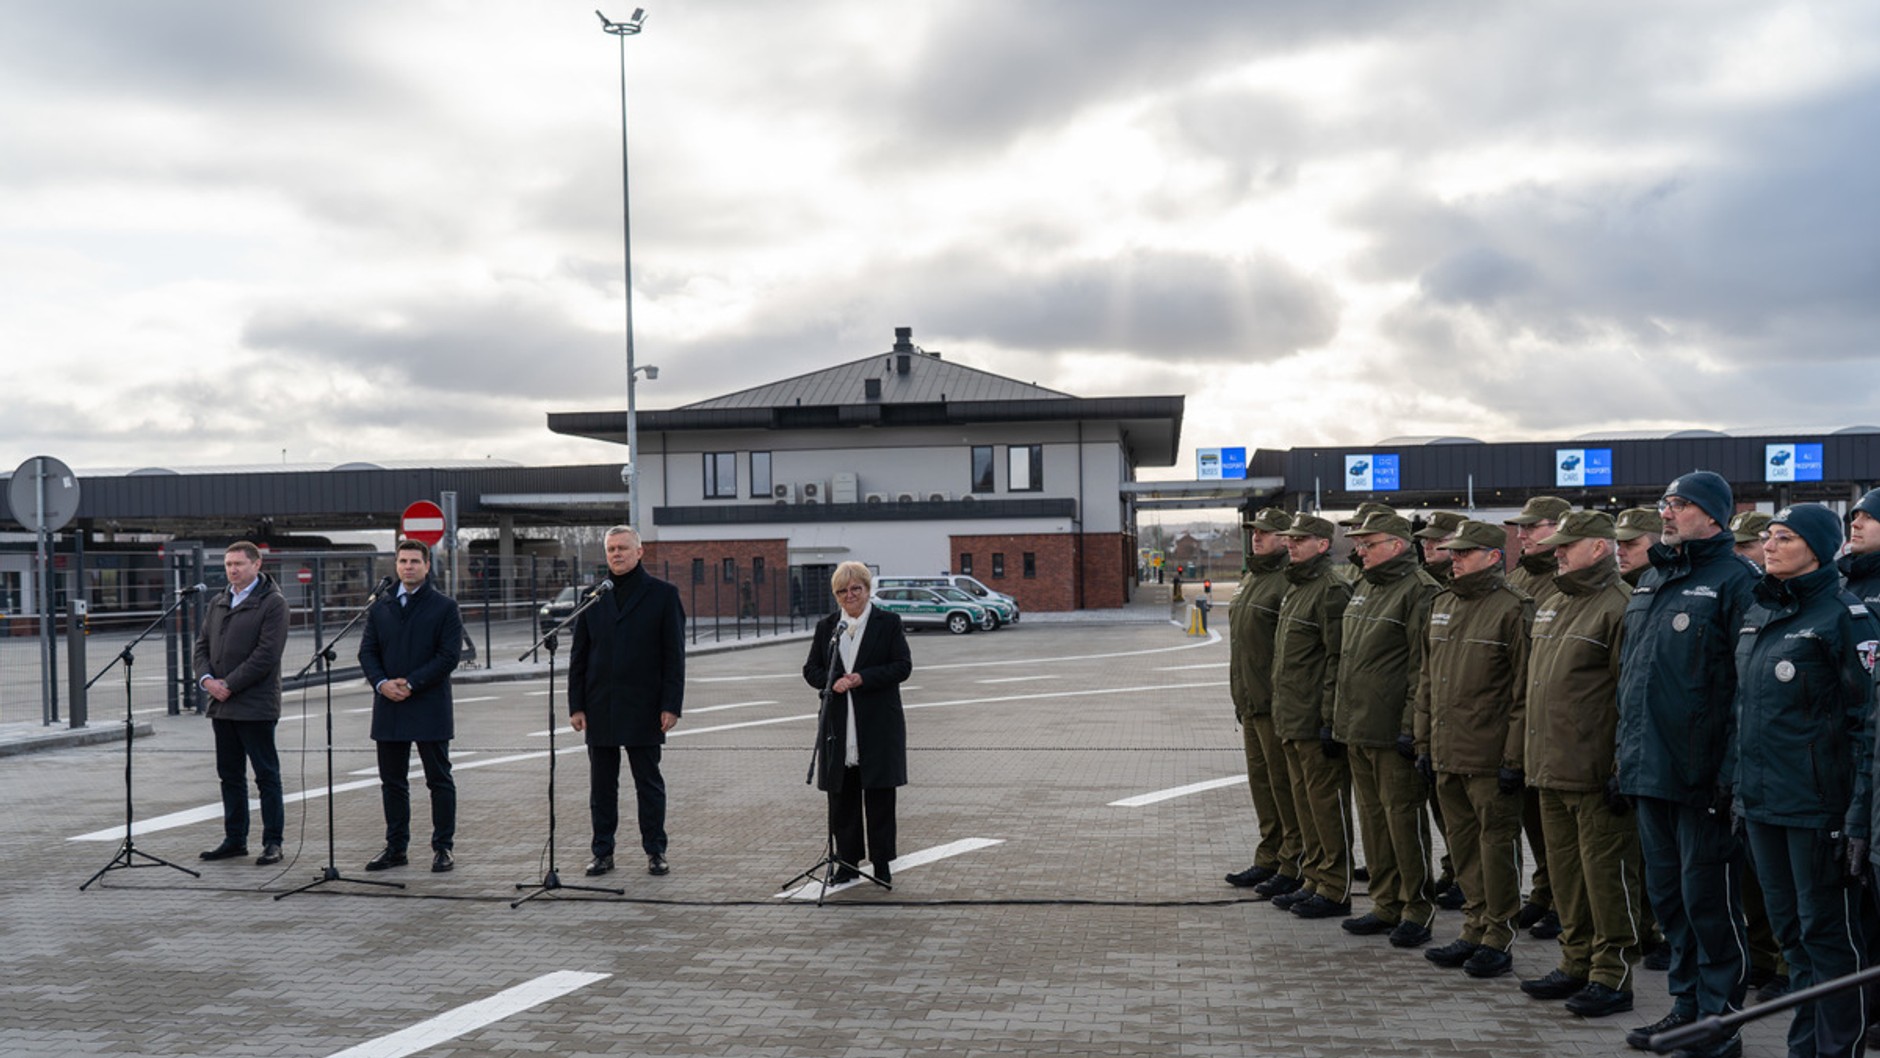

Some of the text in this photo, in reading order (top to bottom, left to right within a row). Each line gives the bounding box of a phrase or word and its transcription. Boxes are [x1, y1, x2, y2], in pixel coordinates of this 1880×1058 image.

[1772, 468, 1789, 477] CARS
[1351, 477, 1367, 487] CARS
[1563, 473, 1579, 482] CARS
